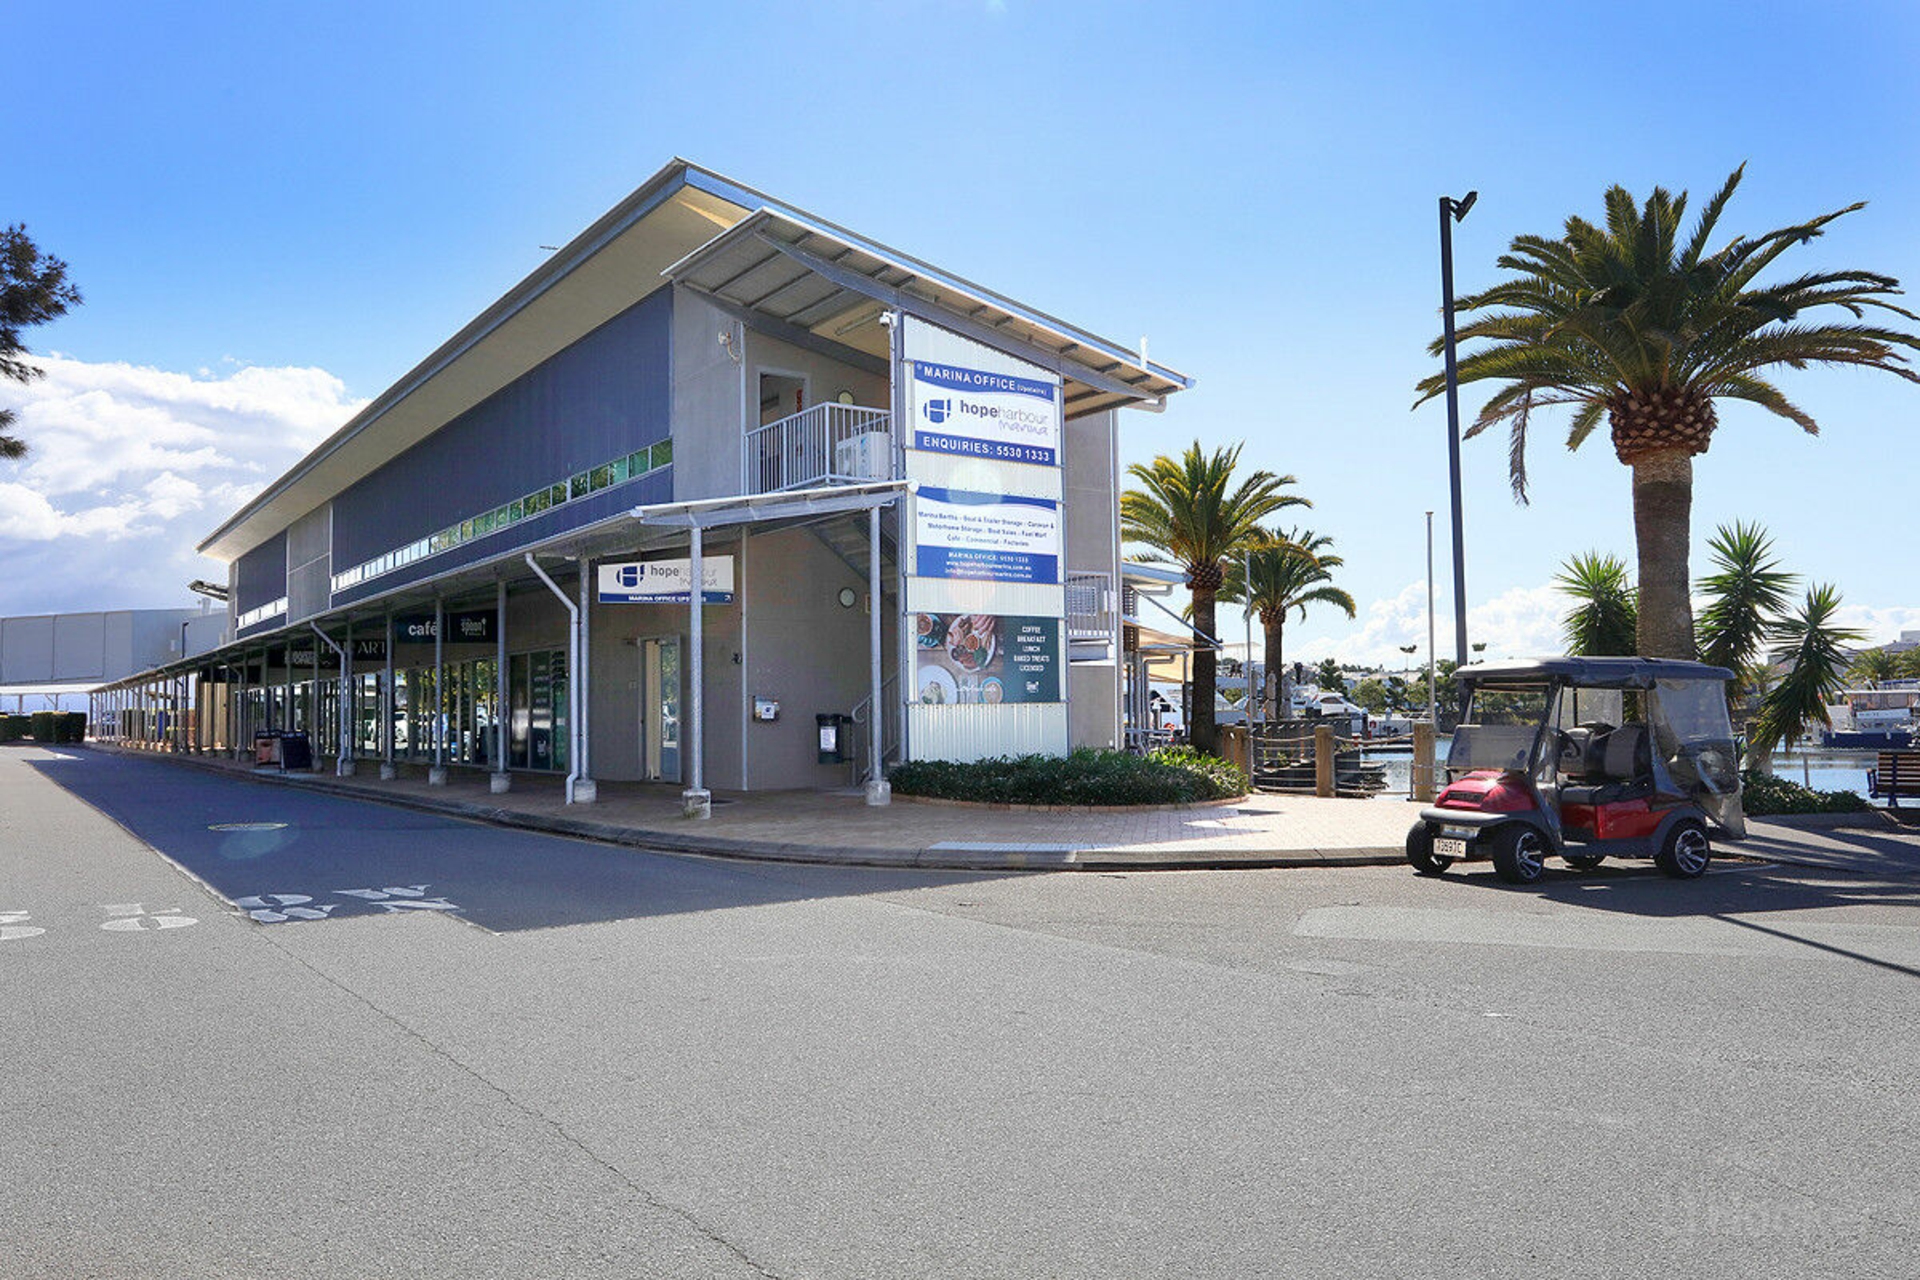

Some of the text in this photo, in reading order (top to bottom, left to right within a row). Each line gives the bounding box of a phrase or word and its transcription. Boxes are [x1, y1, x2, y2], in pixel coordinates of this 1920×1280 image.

[924, 366, 972, 383] MARINA
[973, 373, 1015, 391] OFFICE
[923, 436, 1050, 462] ENQUIRIES: 5530 1333
[1021, 626, 1041, 634] COFFEE
[358, 641, 386, 654] ART
